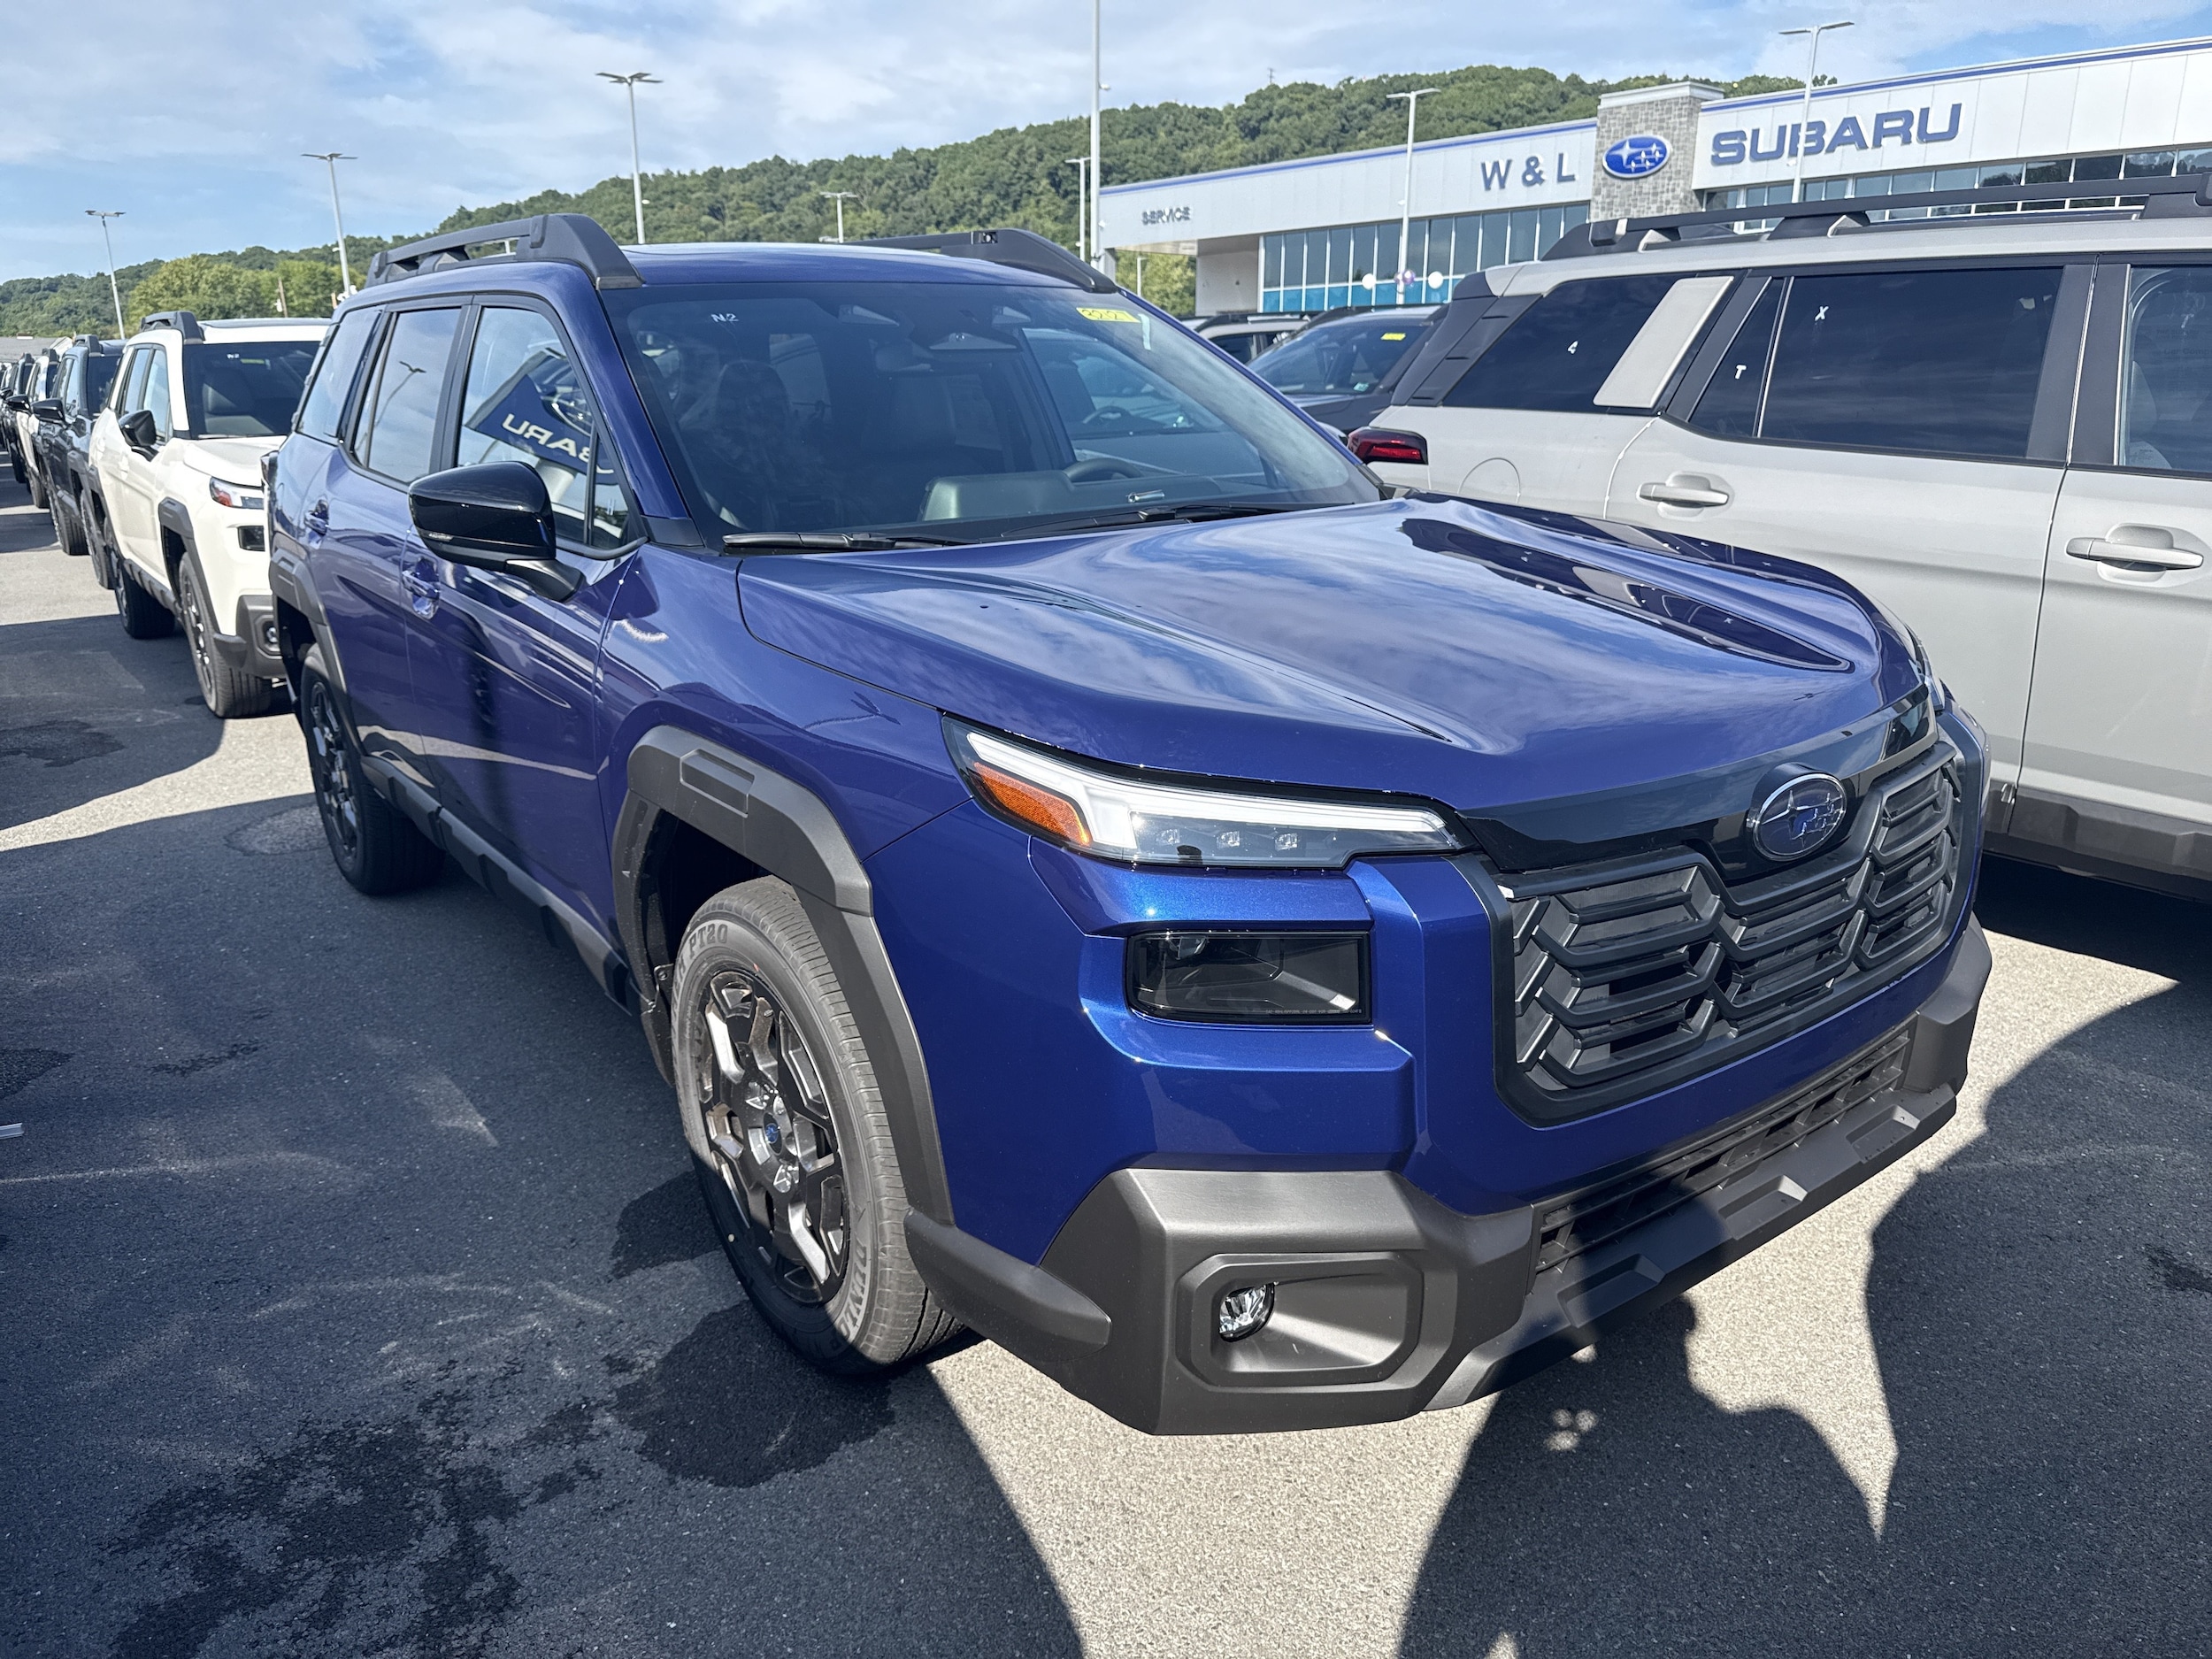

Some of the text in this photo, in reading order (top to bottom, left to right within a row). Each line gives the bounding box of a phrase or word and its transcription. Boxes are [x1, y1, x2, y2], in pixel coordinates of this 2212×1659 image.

[1711, 103, 1962, 166] SUBARU
[1481, 152, 1575, 191] W & L
[1141, 206, 1191, 226] SERVICE
[1734, 365, 1747, 380] T
[688, 923, 728, 959] PT20
